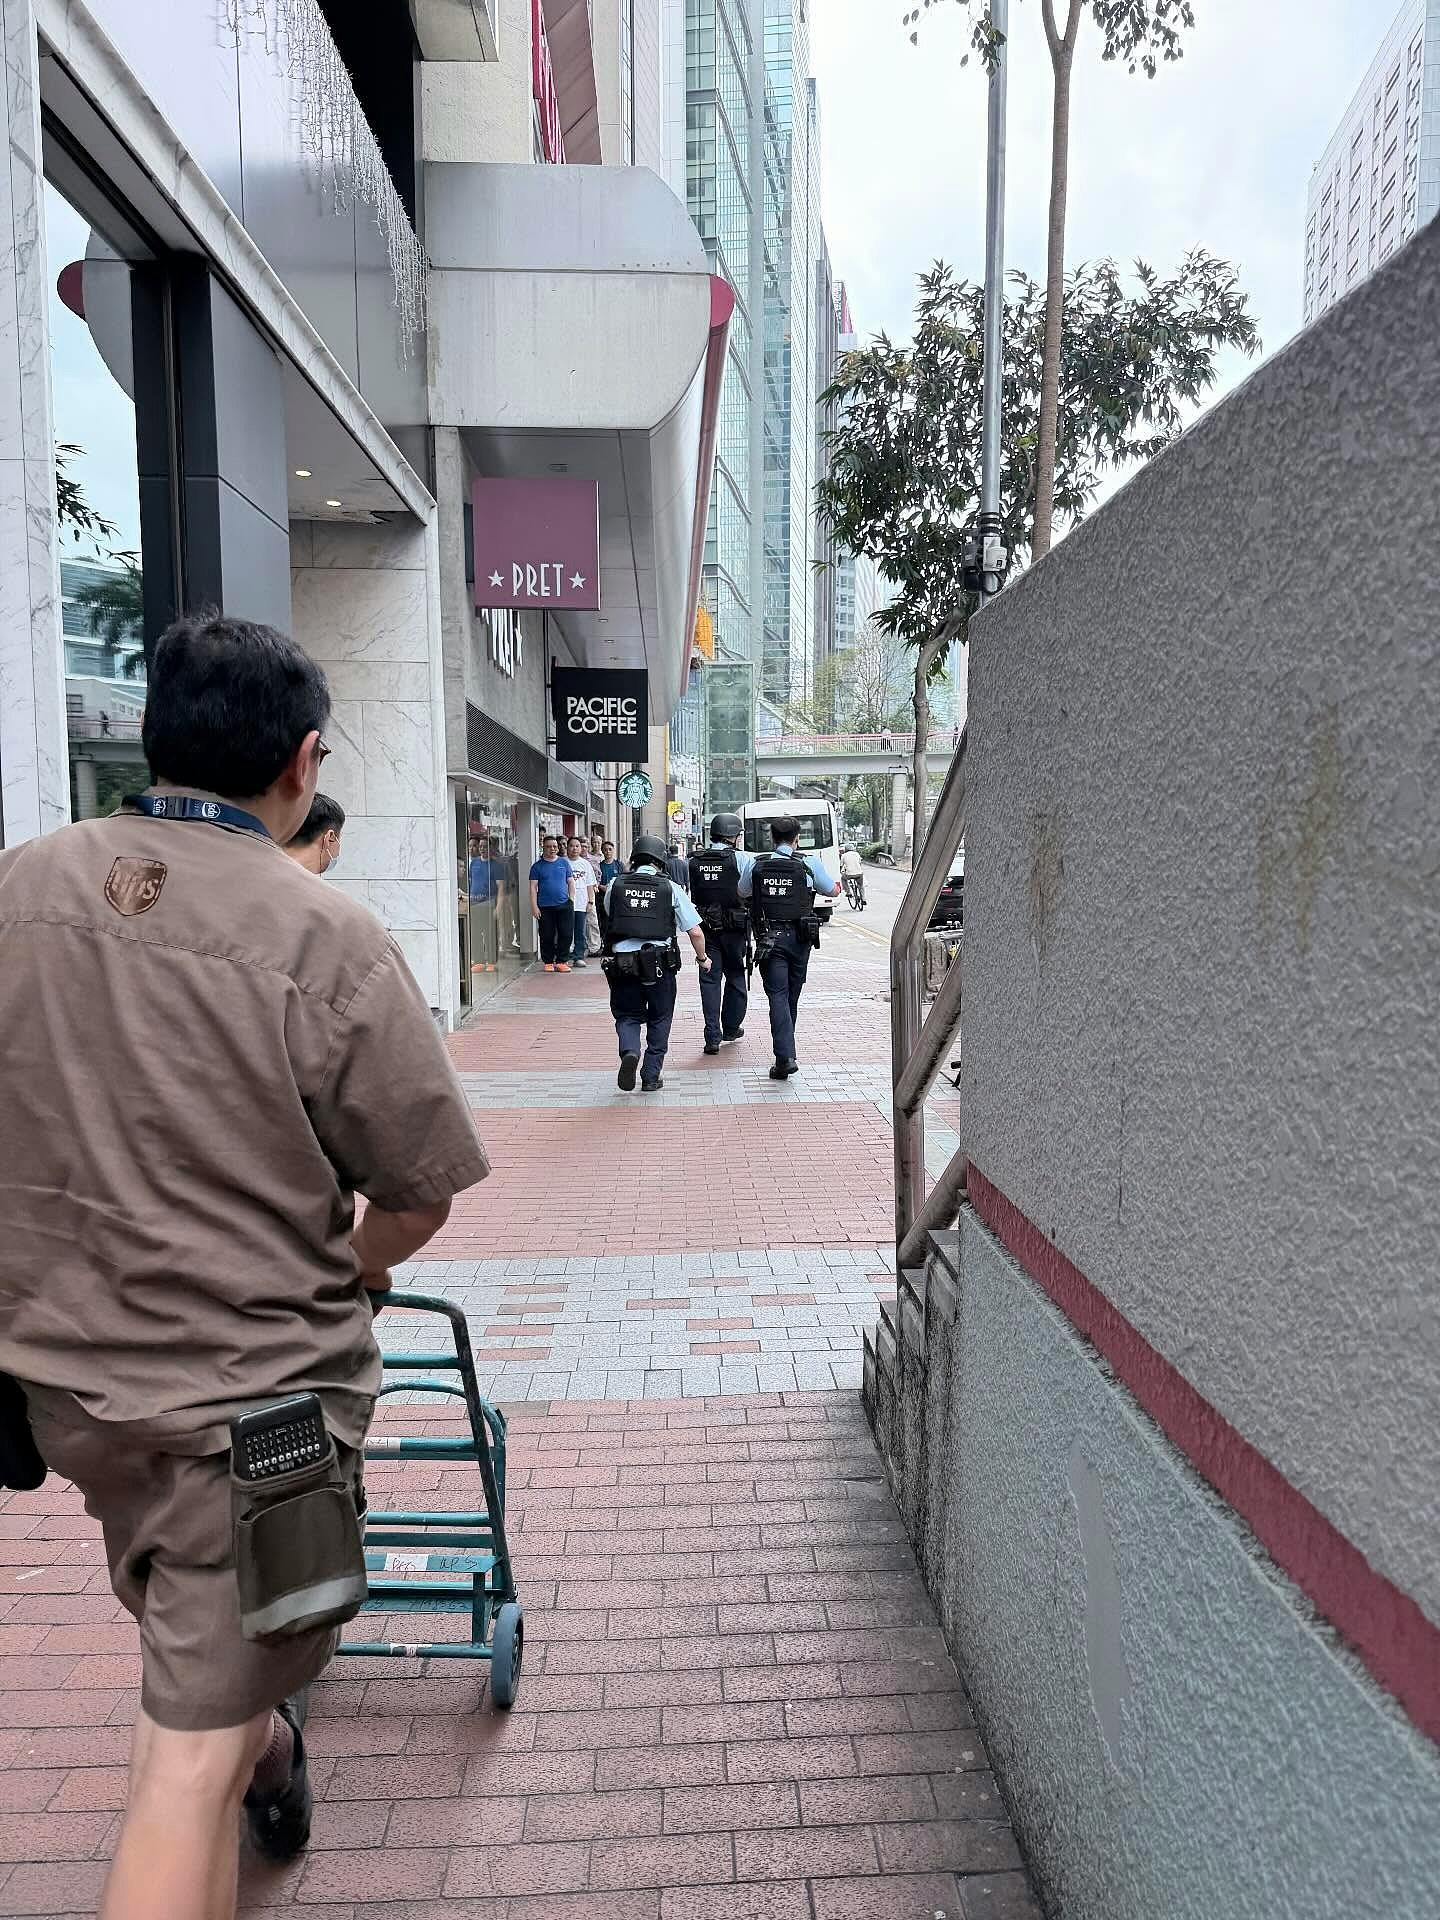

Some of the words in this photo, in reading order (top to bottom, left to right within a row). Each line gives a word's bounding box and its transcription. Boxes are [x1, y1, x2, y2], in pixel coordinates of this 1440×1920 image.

[512, 562, 564, 597] PRET
[567, 696, 637, 716] PACIFIC
[567, 716, 637, 735] COFFEE
[763, 878, 793, 886] POLICE
[625, 889, 657, 899] POLICE
